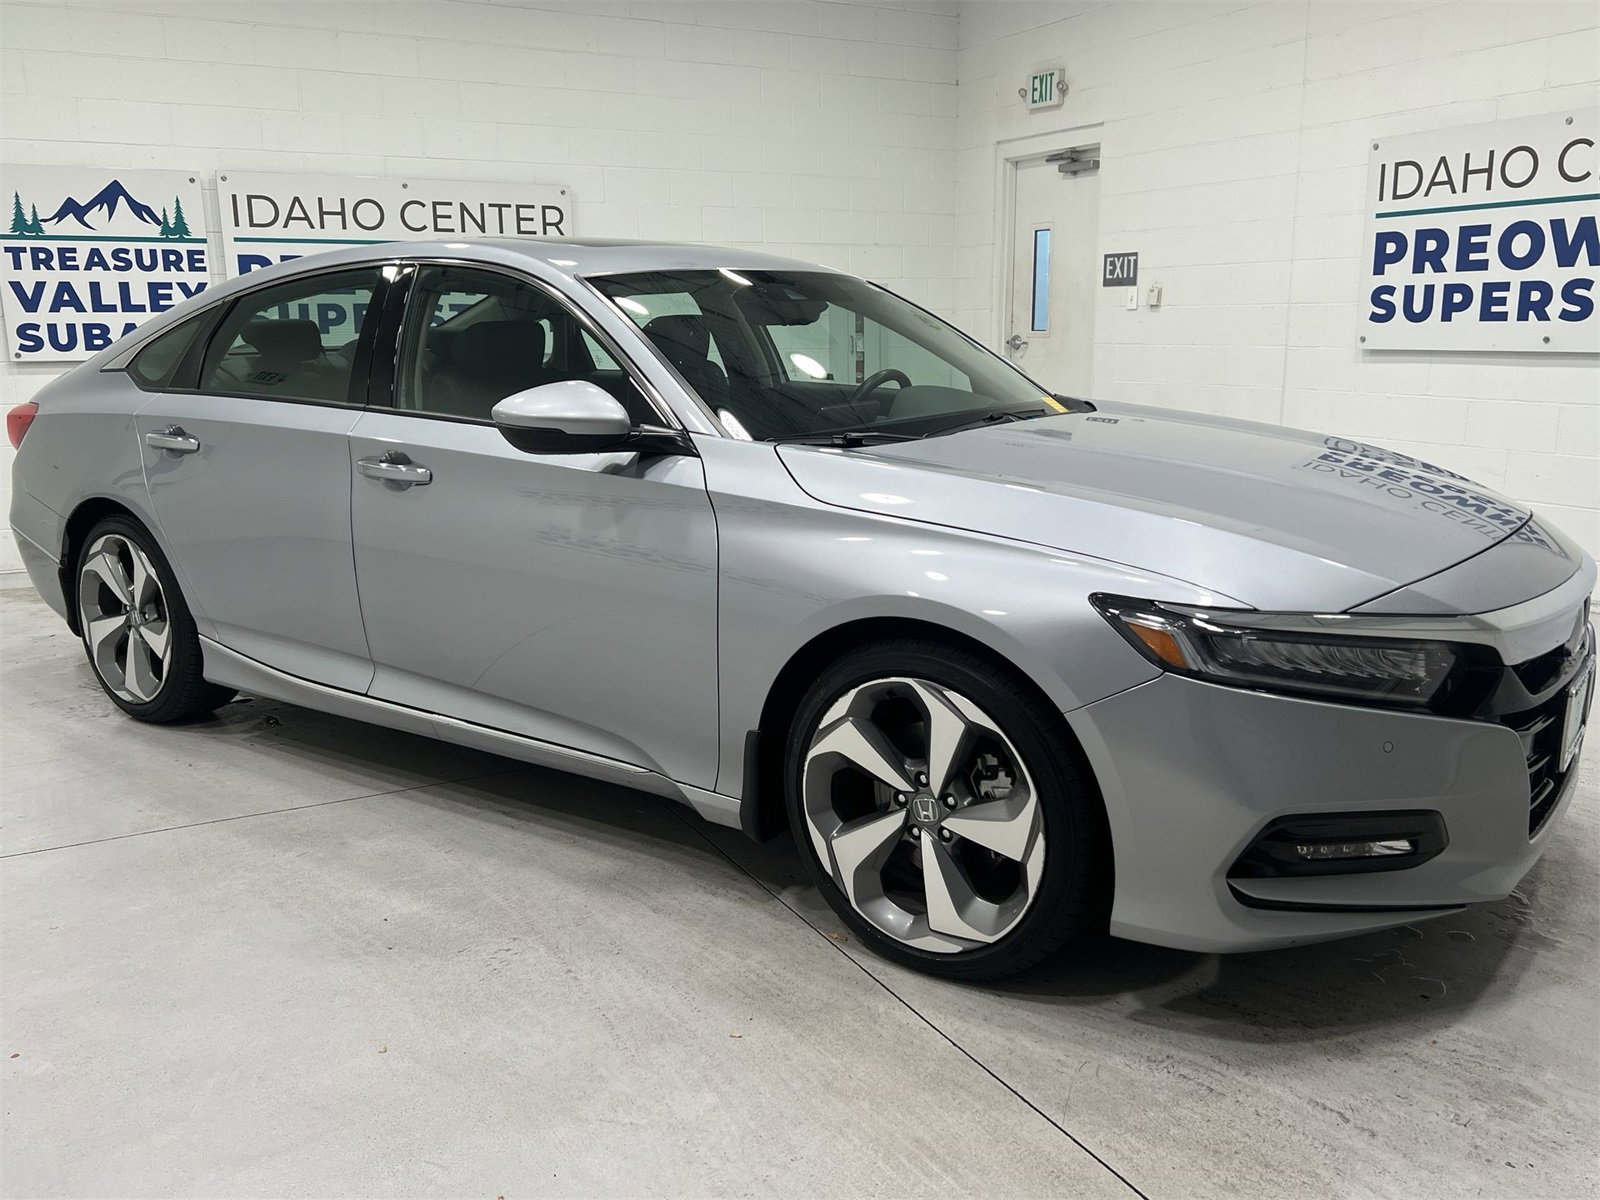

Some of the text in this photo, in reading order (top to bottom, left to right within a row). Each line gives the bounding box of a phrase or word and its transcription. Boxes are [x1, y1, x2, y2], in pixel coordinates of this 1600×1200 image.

[1032, 72, 1055, 104] EXIT
[1379, 138, 1600, 202] IDAHO C
[231, 193, 566, 236] IDAHO CENTER
[4, 246, 208, 272] TREASURE
[1106, 256, 1137, 279] EXIT
[1368, 278, 1596, 324] SUPERS
